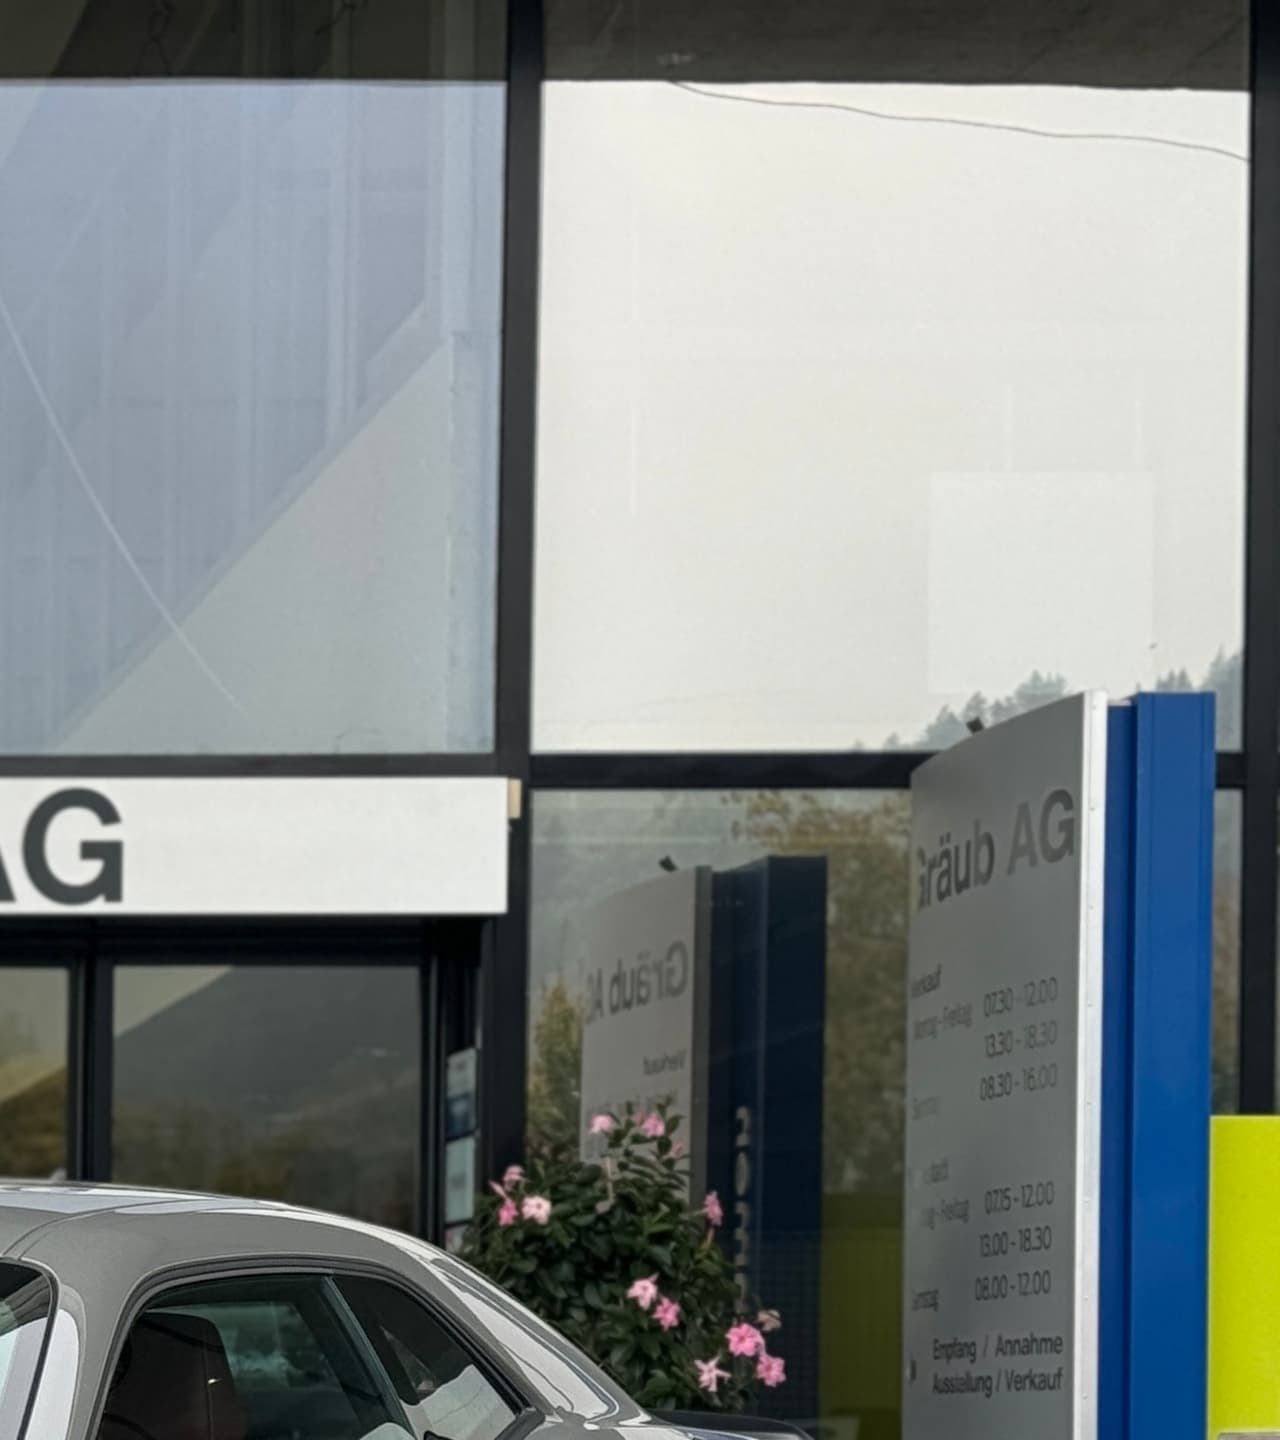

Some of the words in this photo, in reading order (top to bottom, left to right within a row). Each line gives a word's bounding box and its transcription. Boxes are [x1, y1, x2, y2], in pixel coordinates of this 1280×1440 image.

[1006, 788, 1075, 876] AG
[1022, 976, 1058, 1008] 12.00
[984, 1030, 1014, 1059] 13.30
[1022, 1019, 1058, 1049] 18.30
[979, 1071, 1013, 1101] 08.30
[1021, 1063, 1058, 1093] 16.00
[1020, 1180, 1055, 1209] 12.00
[978, 1230, 1009, 1258] 13.00
[1018, 1226, 1052, 1252] 18.30
[975, 1275, 1009, 1302] 08.00
[1017, 1269, 1052, 1297] 12.00
[932, 1336, 977, 1364] Empfang
[995, 1331, 1064, 1358] Annahme
[932, 1368, 993, 1398] Ausstellung
[1004, 1366, 1064, 1393] Verkauf
